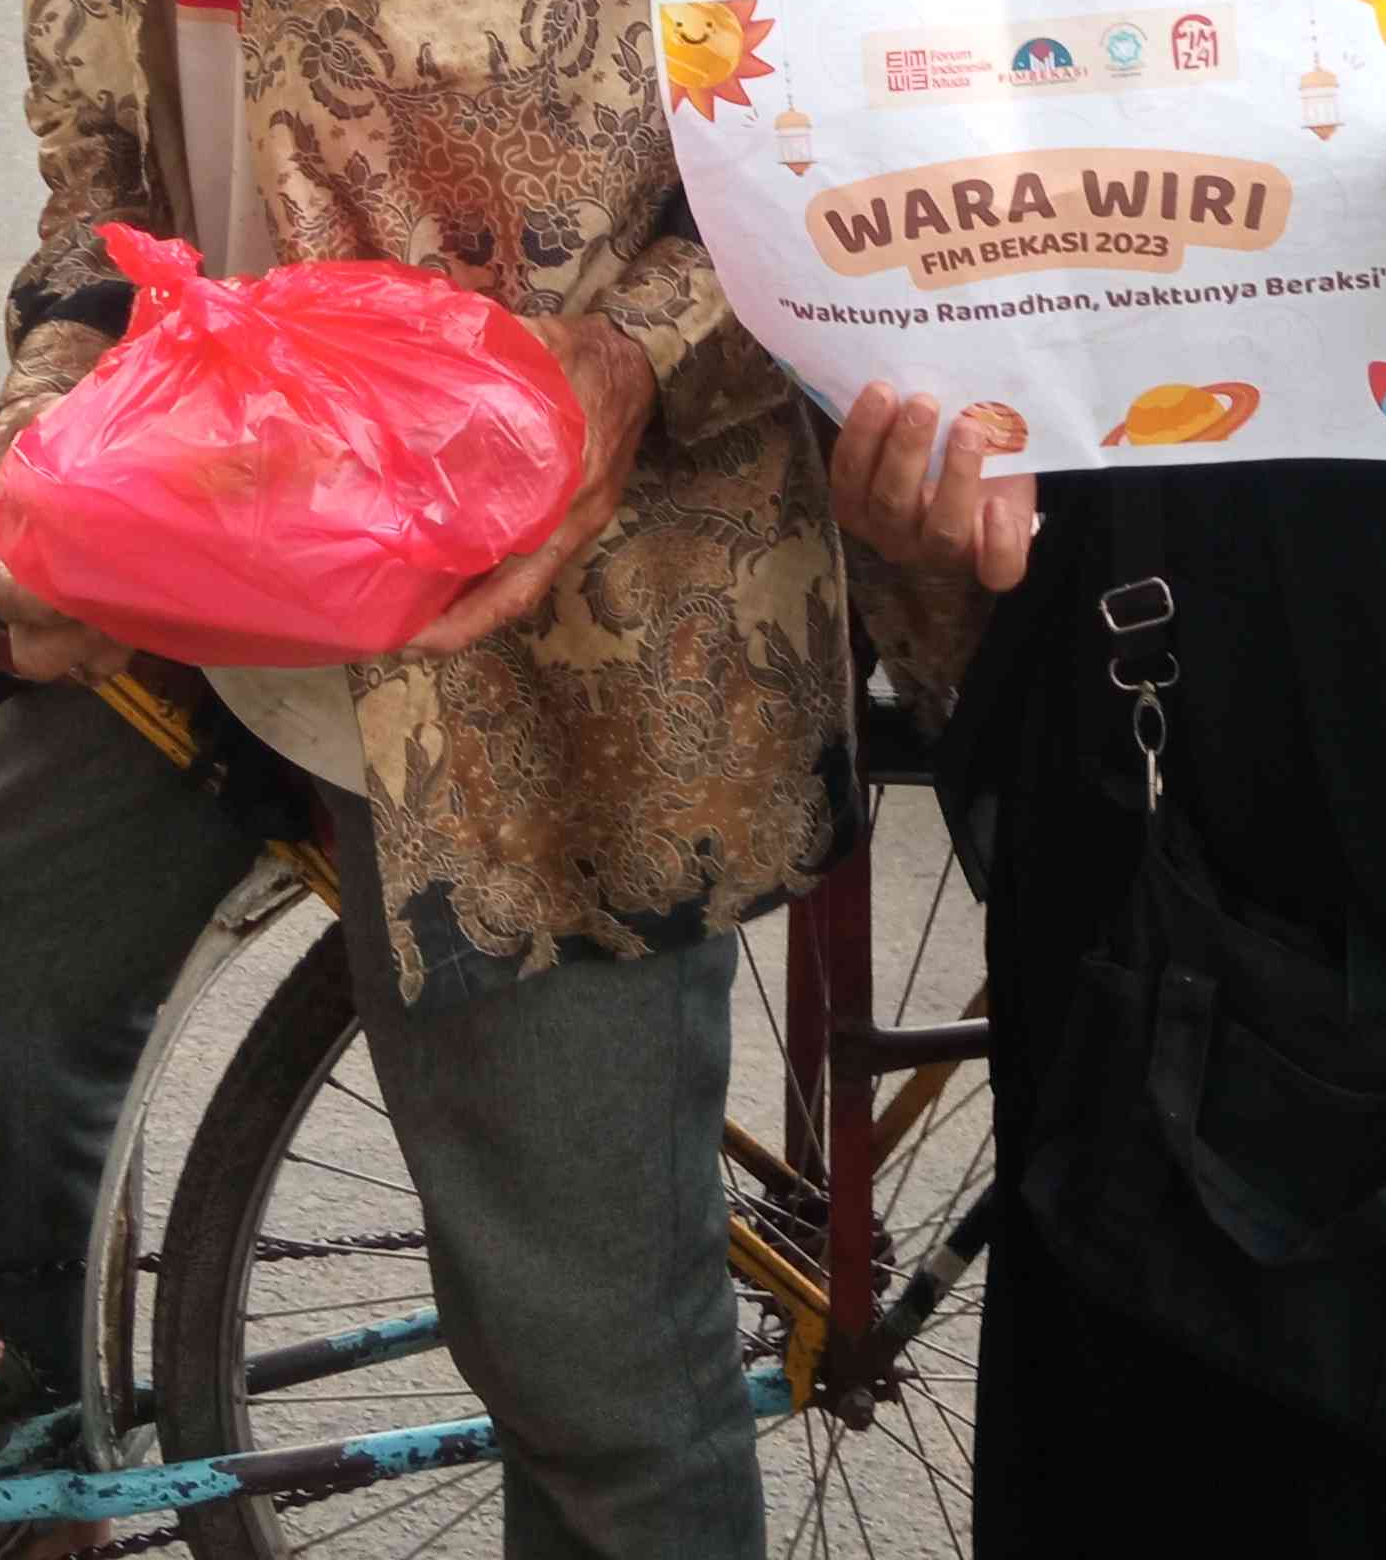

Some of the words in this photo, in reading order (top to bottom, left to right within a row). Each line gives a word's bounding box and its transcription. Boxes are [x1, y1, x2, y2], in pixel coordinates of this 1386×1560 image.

[824, 171, 1055, 257] WARA
[1080, 169, 1268, 233] WIRI
[919, 245, 977, 276] FIM
[980, 232, 1090, 267] BEKASI
[1094, 231, 1170, 258] 2023
[779, 296, 930, 330] "Waktunya
[936, 290, 1101, 324] Ramadhan,
[1104, 280, 1260, 314] Waktunya
